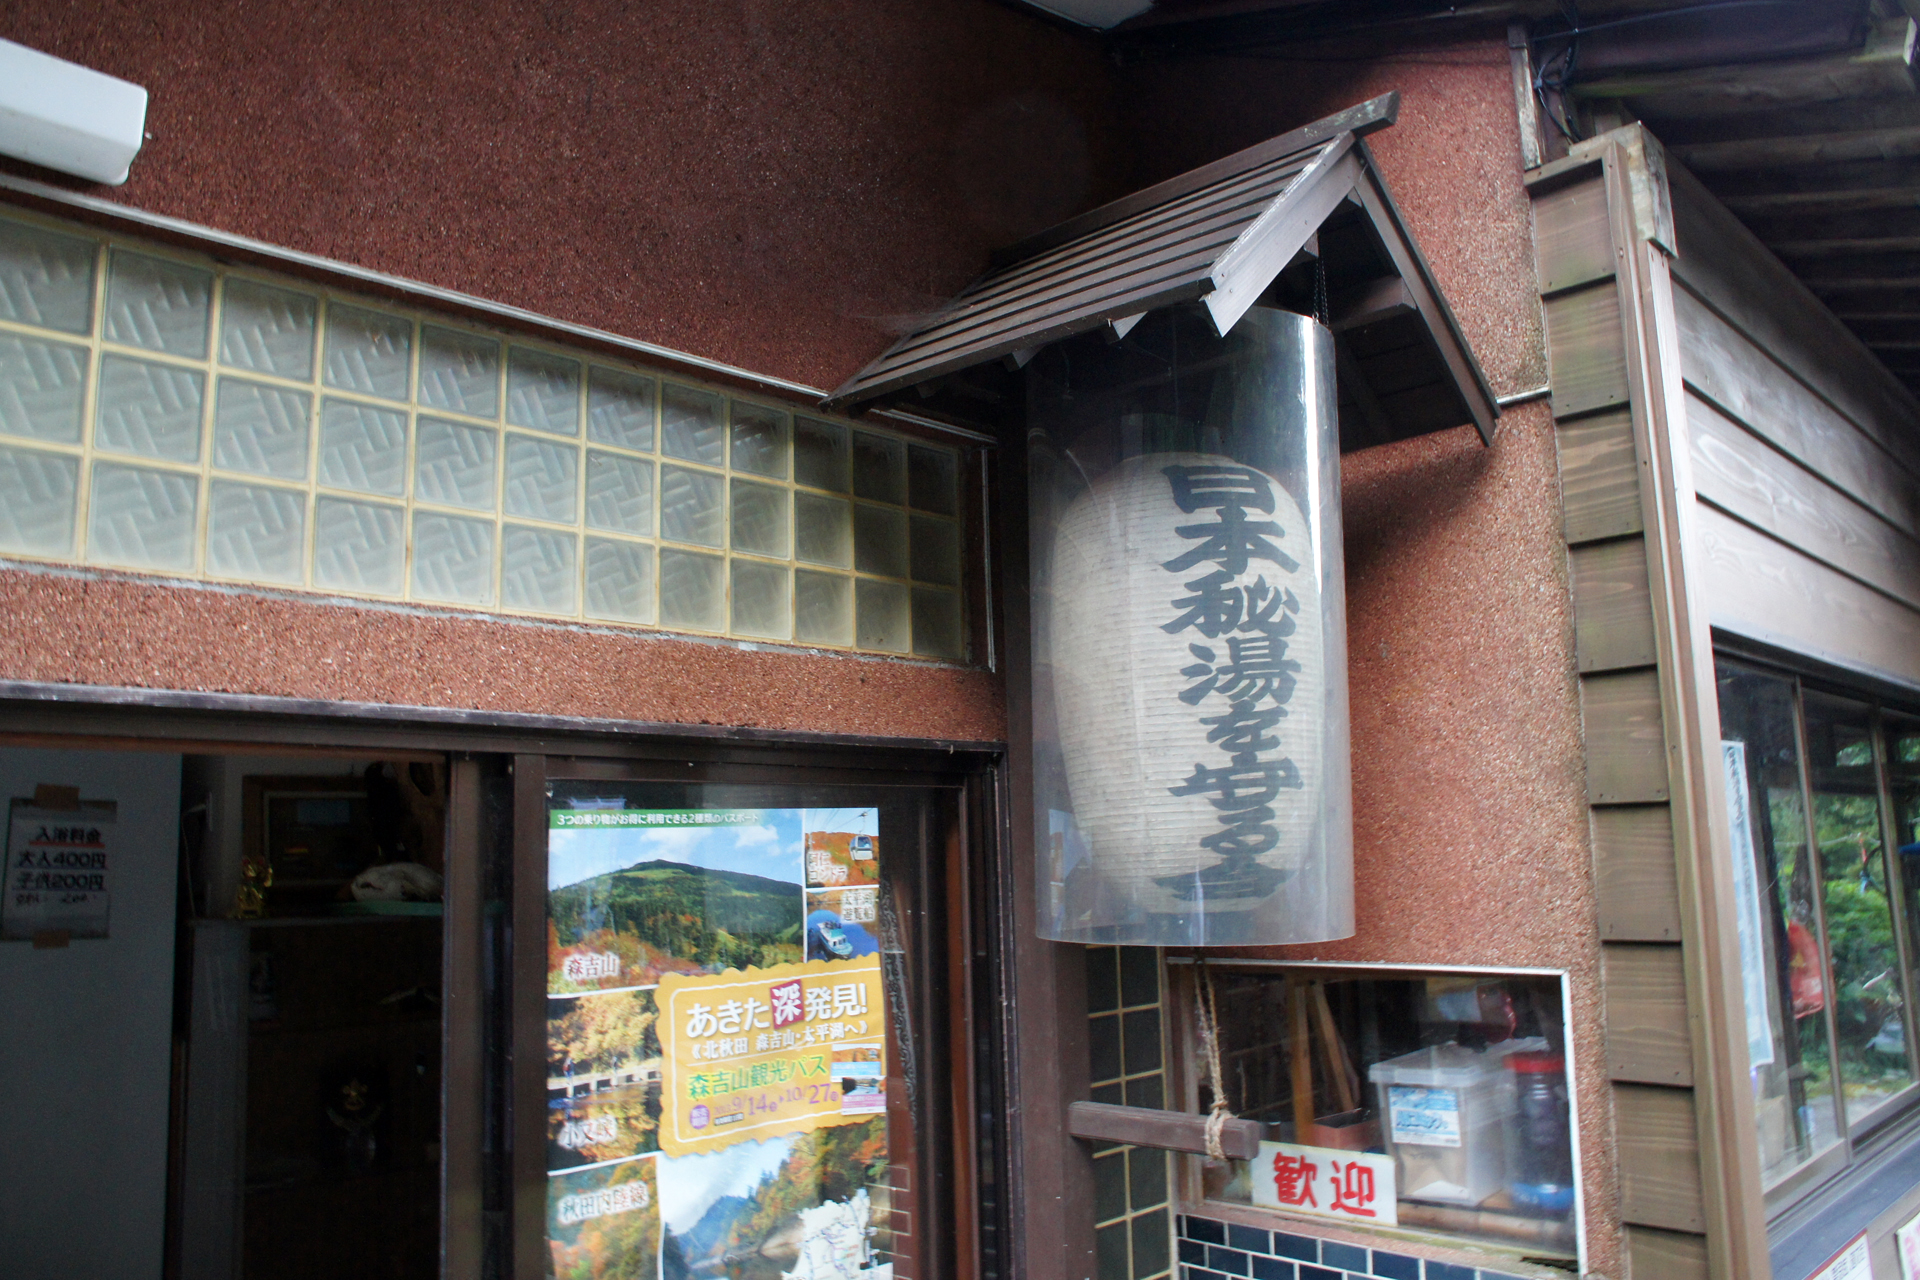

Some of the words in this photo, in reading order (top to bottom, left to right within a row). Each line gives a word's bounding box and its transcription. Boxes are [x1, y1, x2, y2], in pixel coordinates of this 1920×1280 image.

[563, 953, 620, 980] 森吉山
[686, 1054, 828, 1101] 森吉山観光パス
[560, 1183, 647, 1222] 秋田内陸線
[1273, 1151, 1376, 1217] 歓迎
